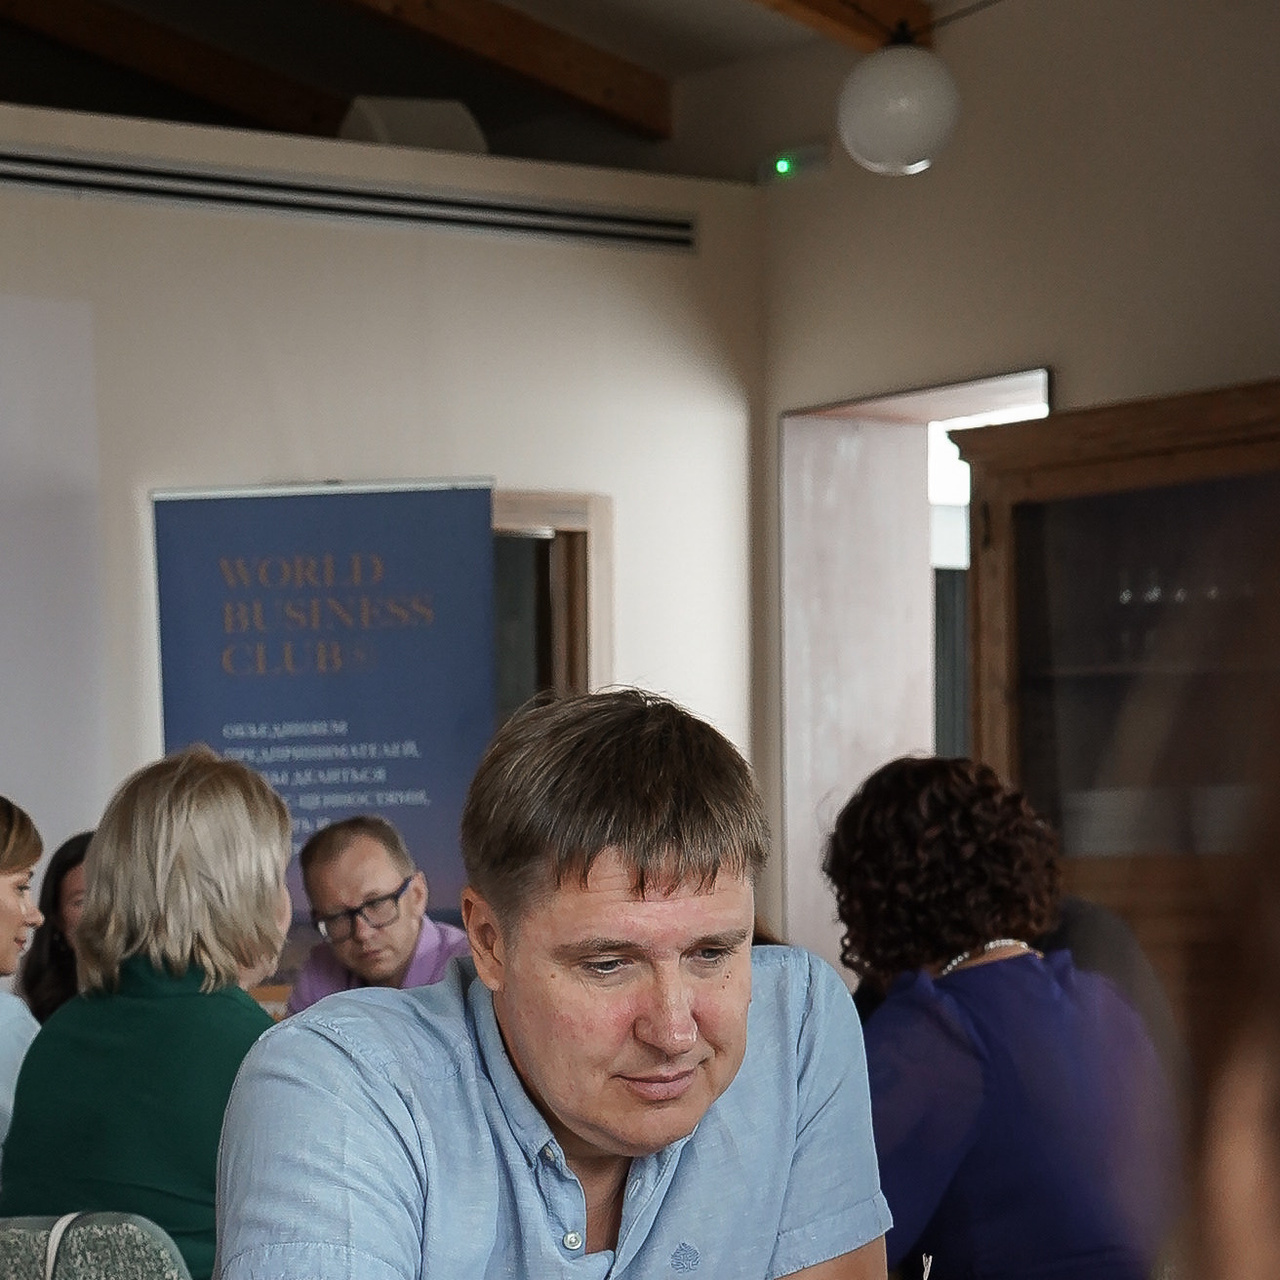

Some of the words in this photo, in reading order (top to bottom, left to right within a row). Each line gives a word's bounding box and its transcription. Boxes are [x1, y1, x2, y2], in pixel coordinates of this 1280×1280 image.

[219, 553, 384, 588] WORLD
[223, 593, 435, 634] BUSINESS
[221, 639, 344, 675] CLUB
